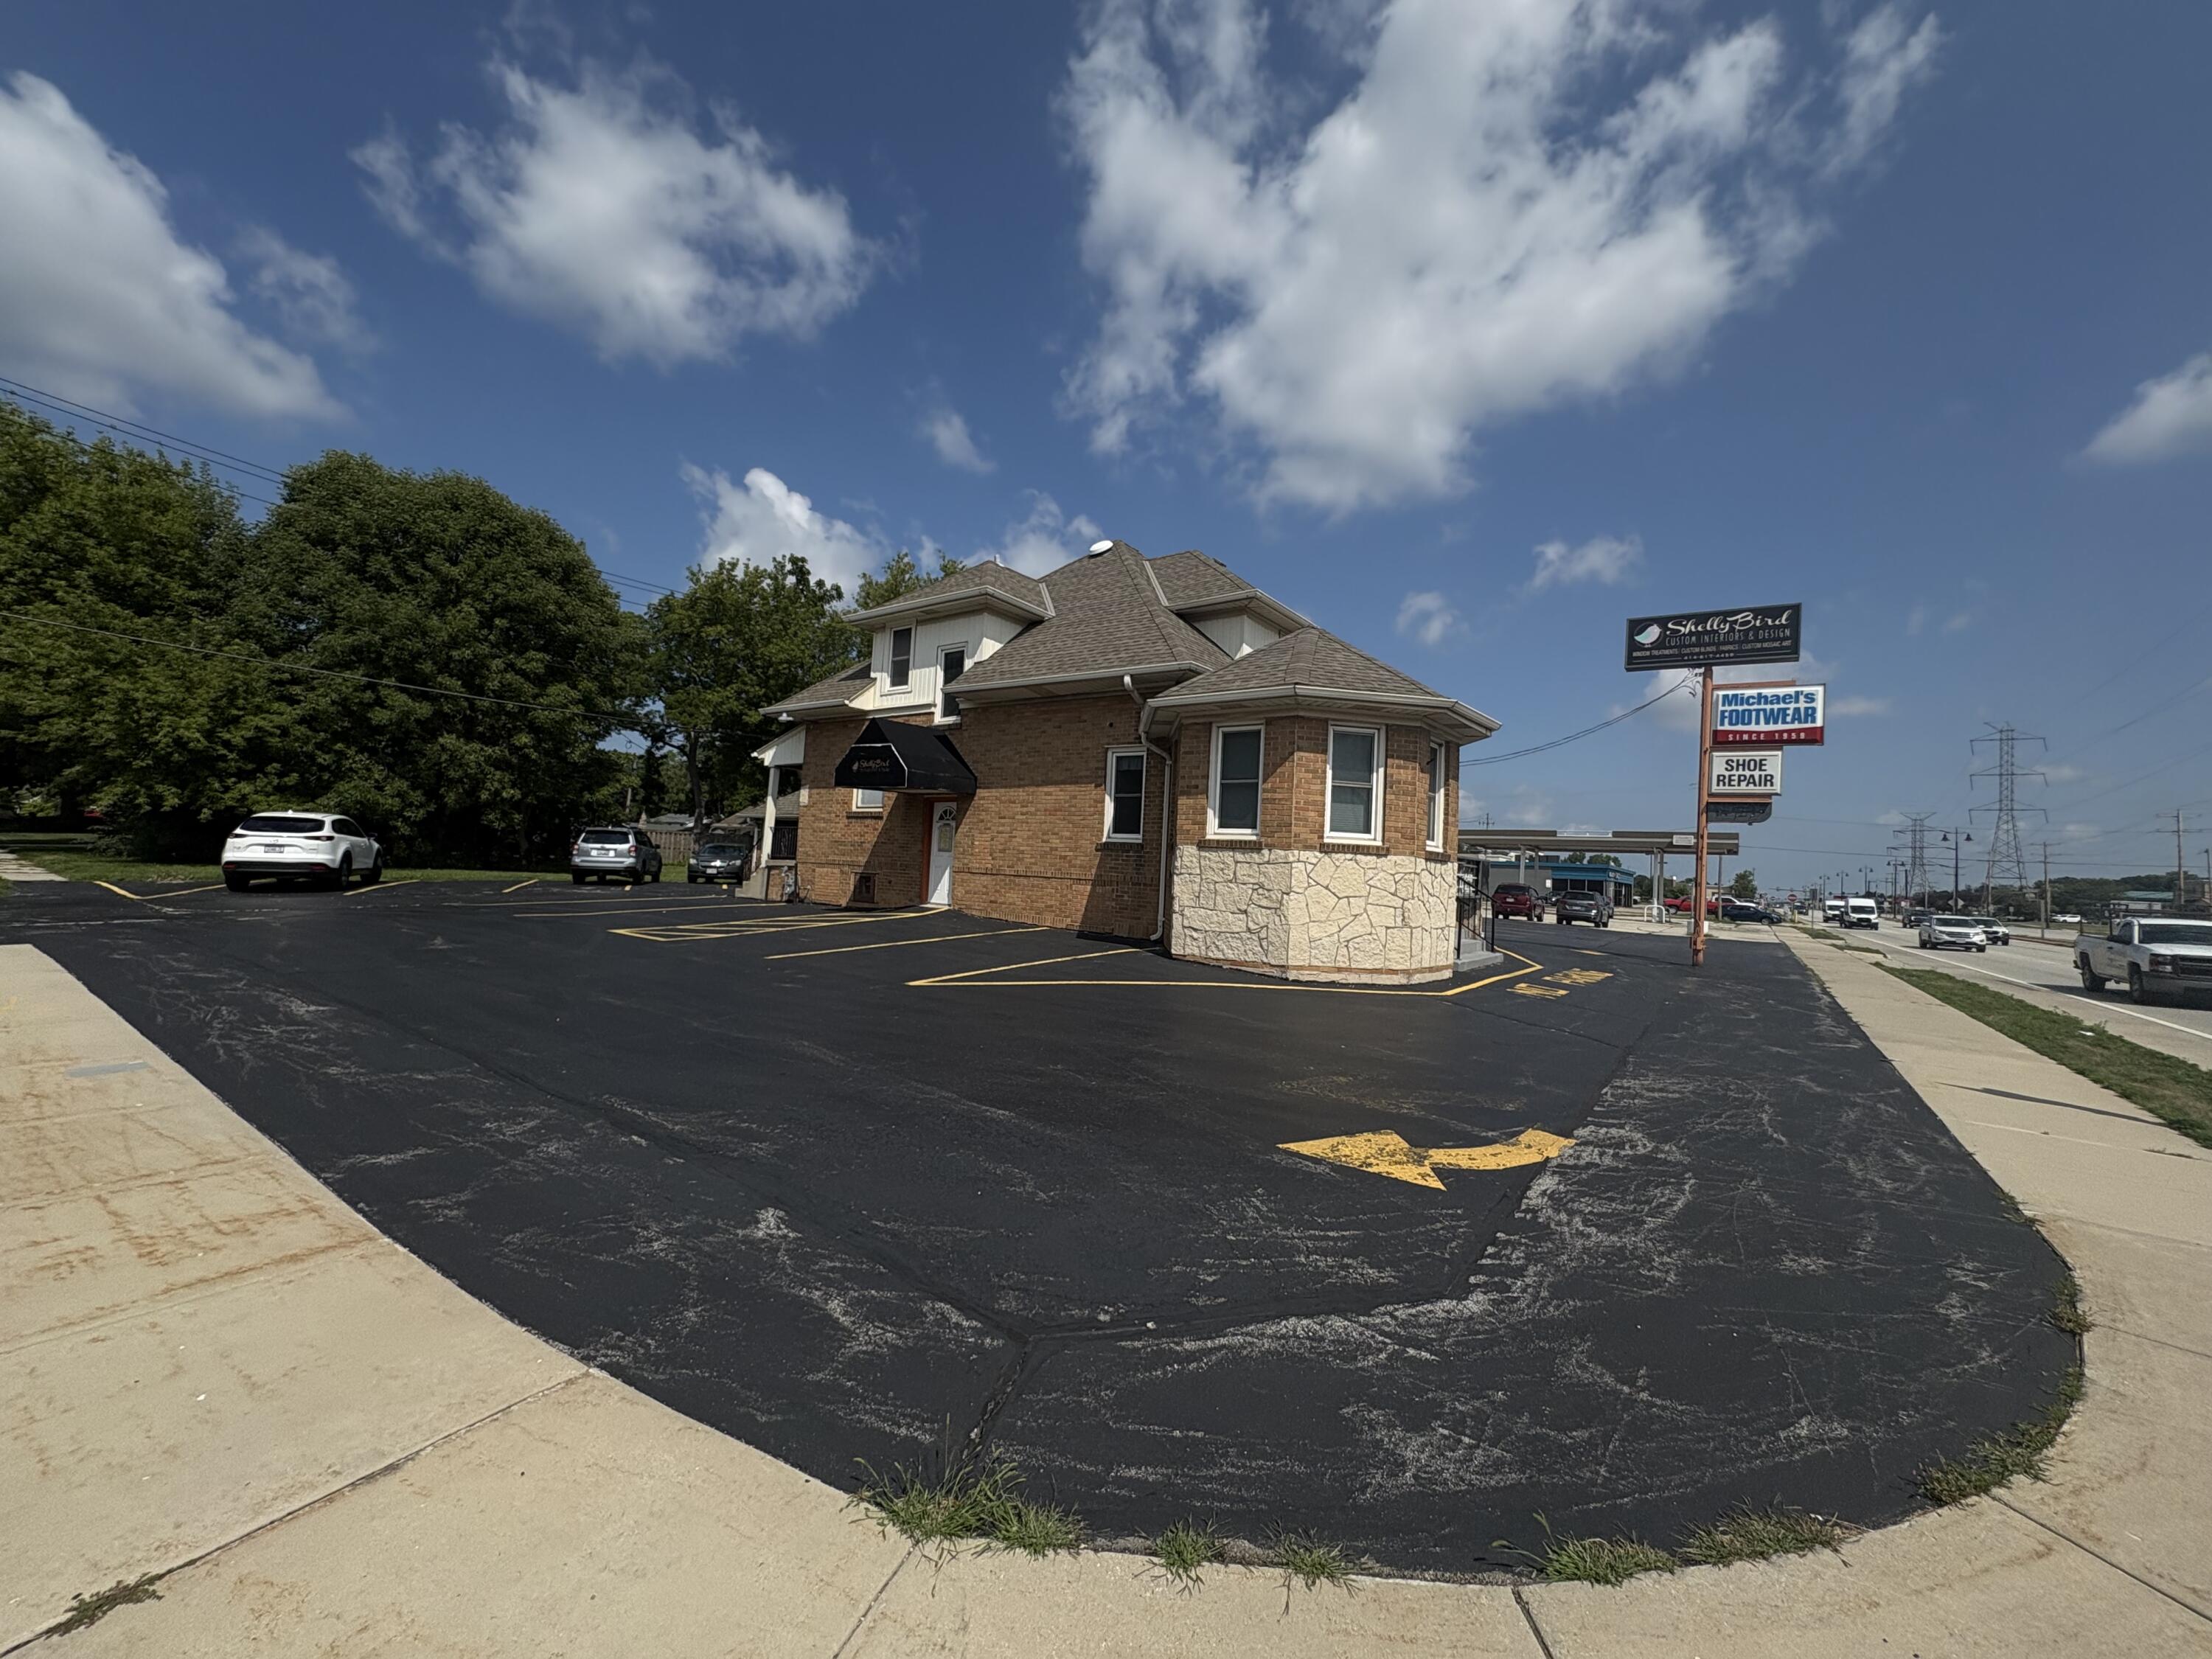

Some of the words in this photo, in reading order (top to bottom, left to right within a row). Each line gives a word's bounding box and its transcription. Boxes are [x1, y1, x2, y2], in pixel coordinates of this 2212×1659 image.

[1666, 636, 1696, 647] CUSTOM
[1700, 631, 1744, 644] INTERIORS
[1748, 630, 1754, 640] &
[1759, 627, 1790, 639] DESIGN
[1721, 690, 1816, 707] Michael's
[1719, 706, 1817, 726] FOOTWEAR
[1728, 733, 1764, 741] SINCE
[1725, 758, 1767, 772] SHOE
[1716, 774, 1774, 787] REPAIR
